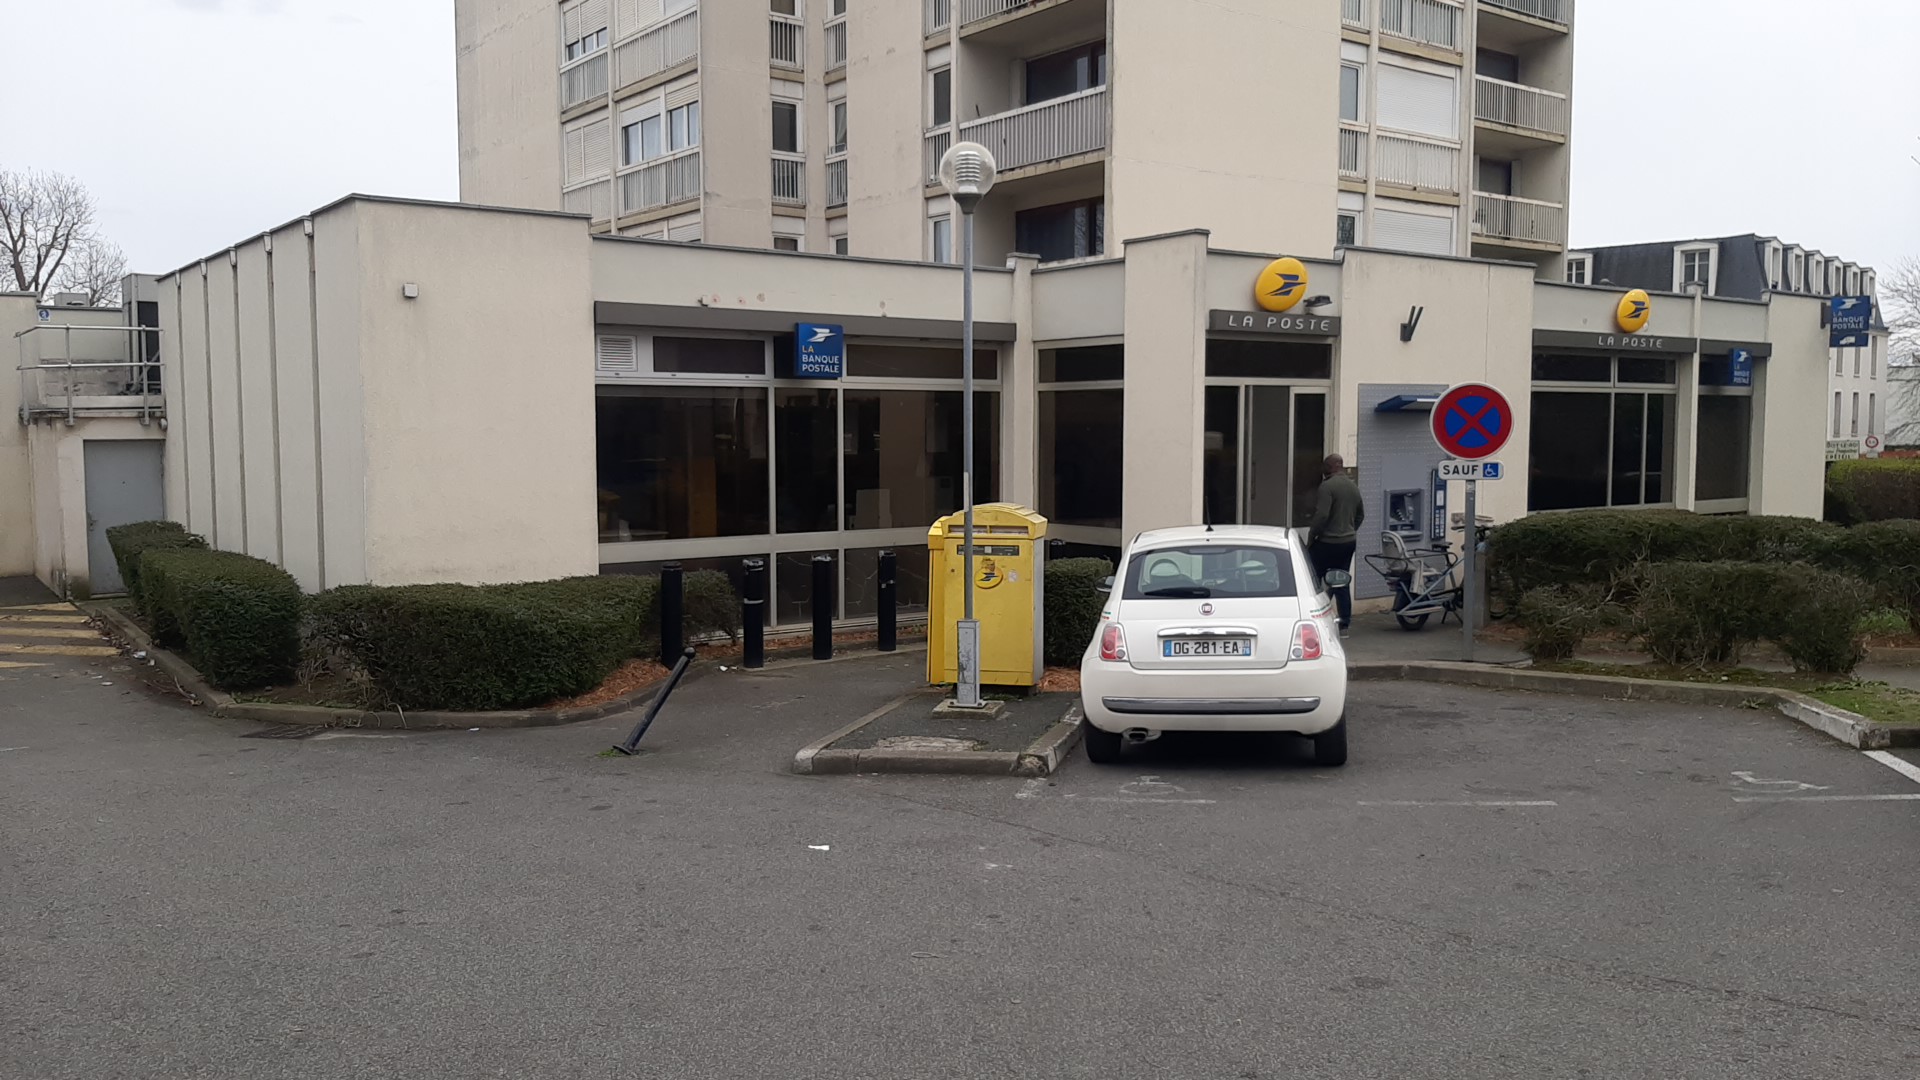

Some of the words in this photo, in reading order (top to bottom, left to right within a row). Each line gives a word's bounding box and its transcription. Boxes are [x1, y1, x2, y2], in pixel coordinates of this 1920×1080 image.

[1228, 315, 1253, 328] LA
[1266, 317, 1330, 331] POSTE
[1598, 336, 1615, 346] LA
[1622, 337, 1663, 349] POSTE
[802, 345, 815, 353] LA
[802, 355, 840, 364] BANQUE
[802, 364, 840, 373] POSTALE
[1443, 464, 1479, 476] SAUF
[1173, 641, 1240, 655] DG-281-EA
